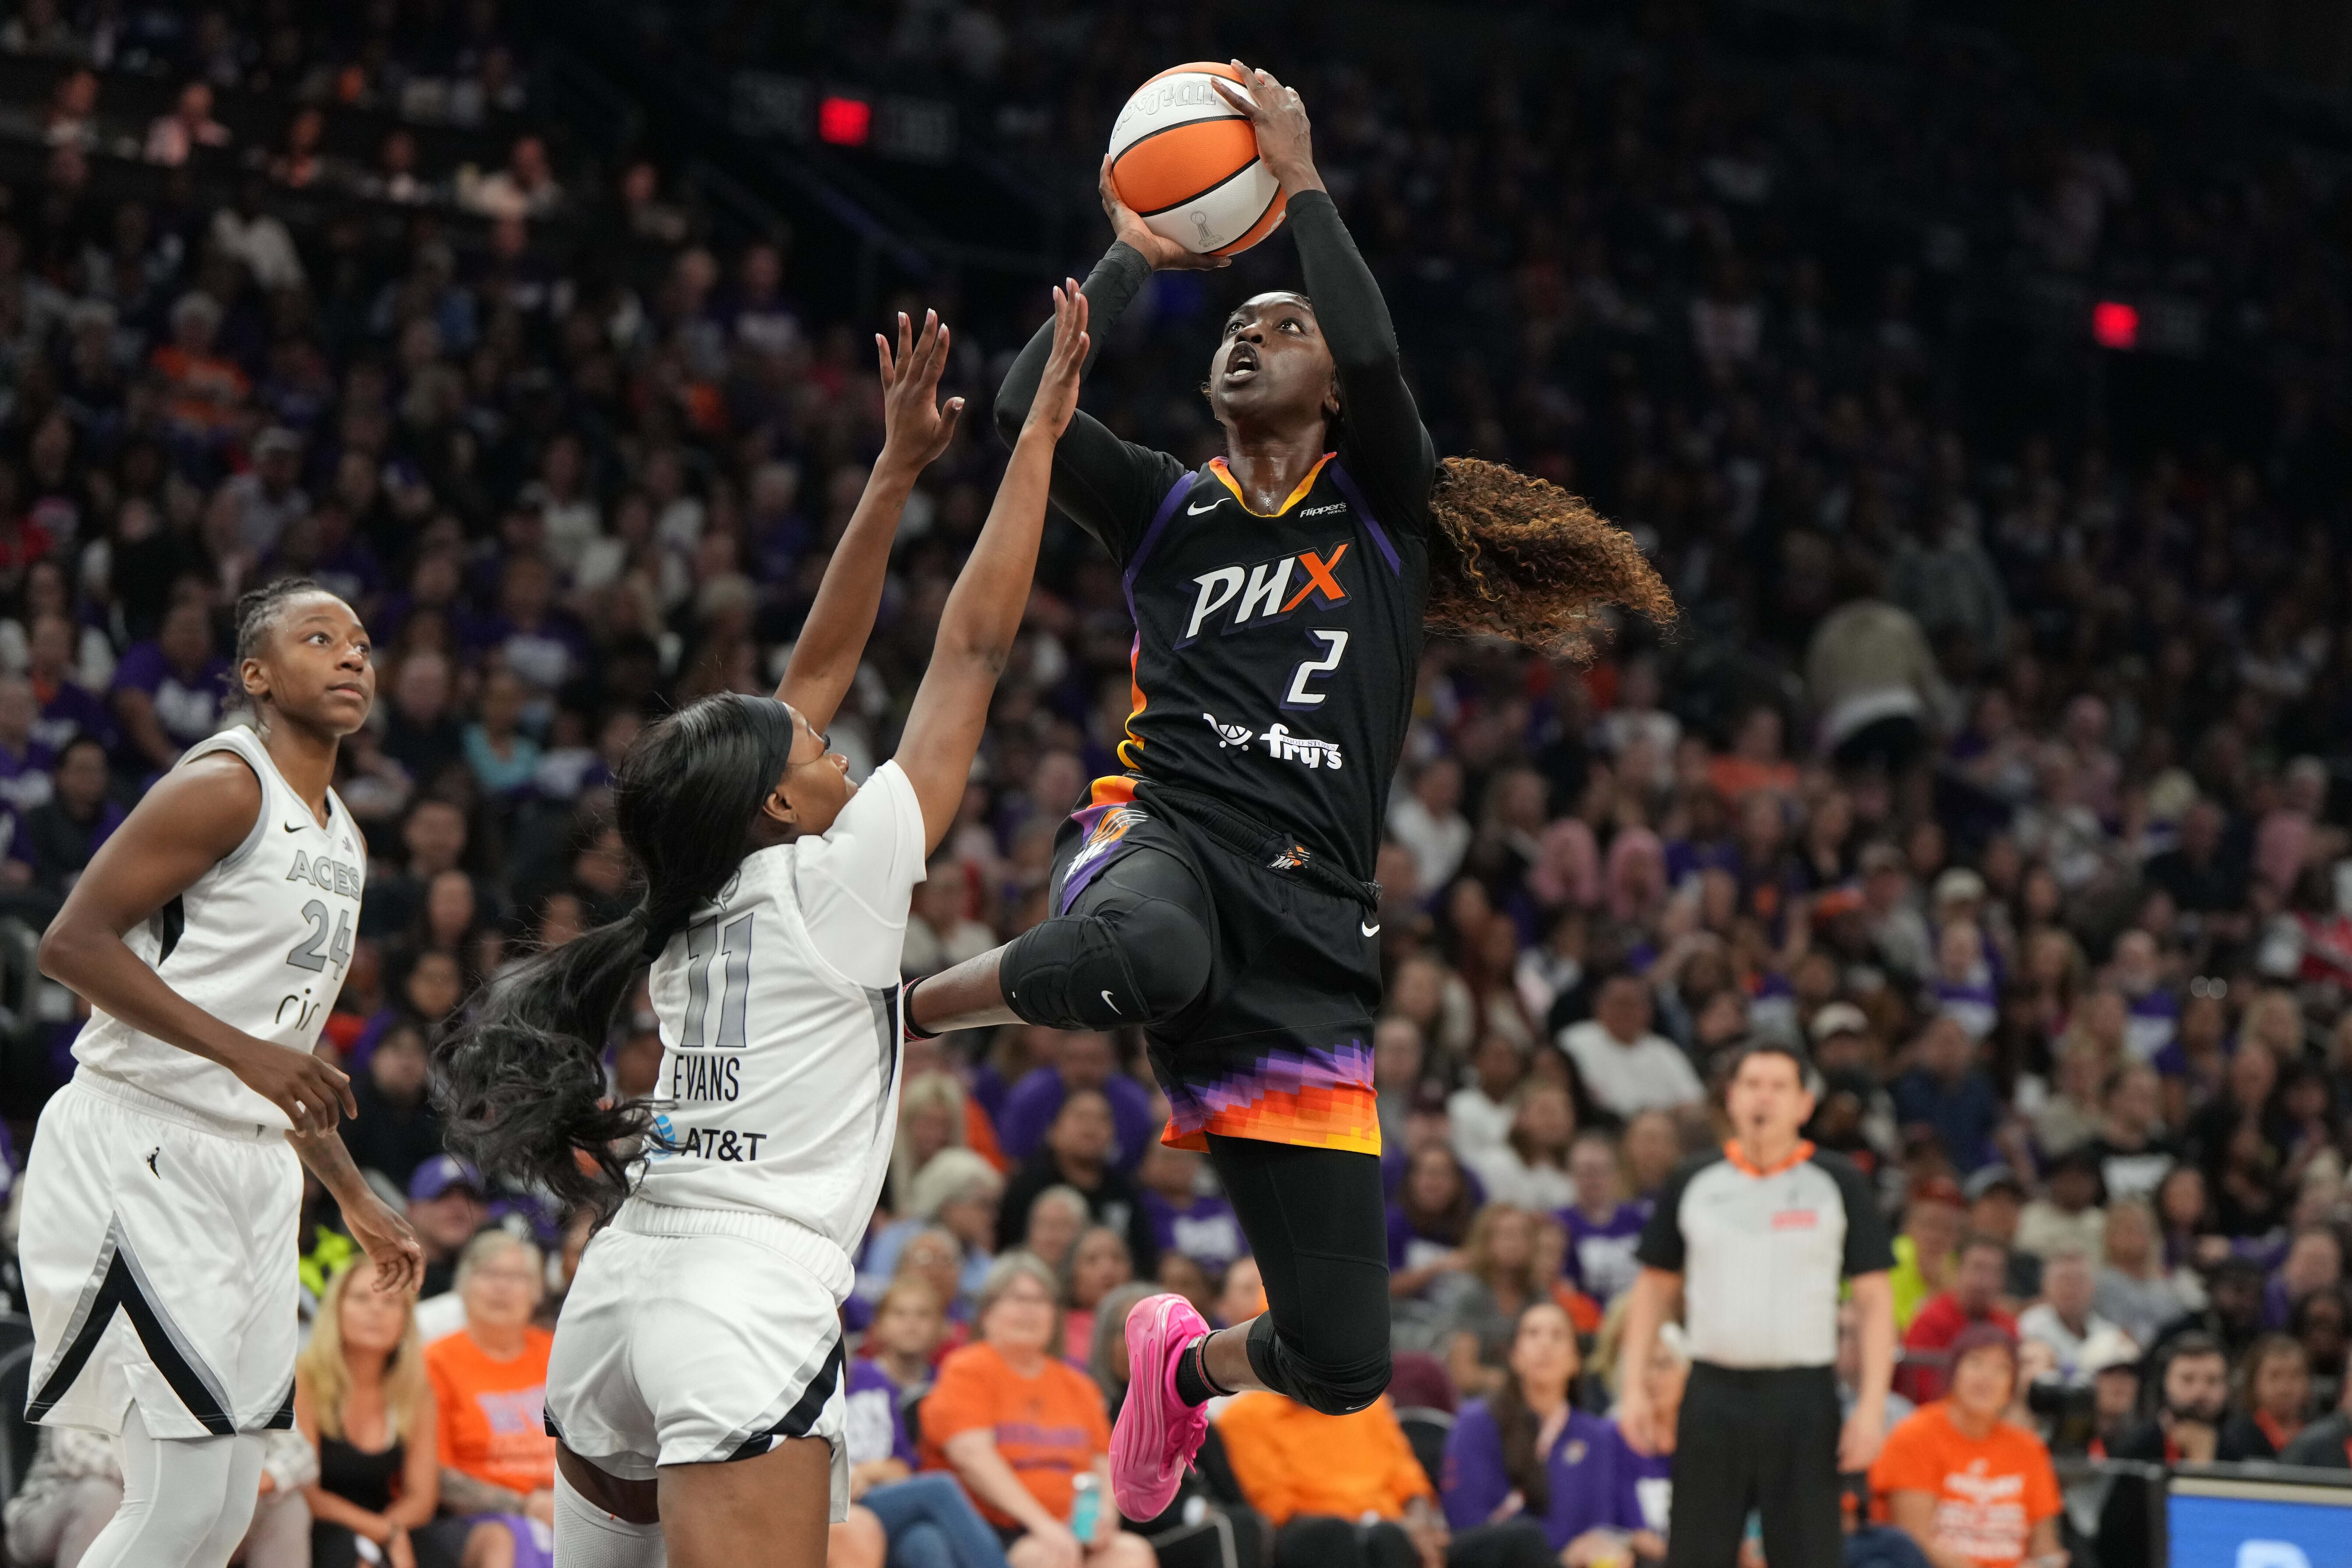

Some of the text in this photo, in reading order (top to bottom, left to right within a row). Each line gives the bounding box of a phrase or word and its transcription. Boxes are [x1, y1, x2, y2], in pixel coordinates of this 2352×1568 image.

[1300, 502, 1346, 518] Flipper's
[1185, 543, 1349, 639] PHX
[1287, 629, 1349, 703] 2
[1259, 723, 1342, 769] fry's
[1283, 736, 1336, 751] FOOD STORES
[286, 849, 361, 902] ACES
[286, 899, 351, 981] 24
[680, 912, 754, 1048] 11
[673, 1055, 739, 1102] EVANS
[681, 1127, 767, 1162] AT&T
